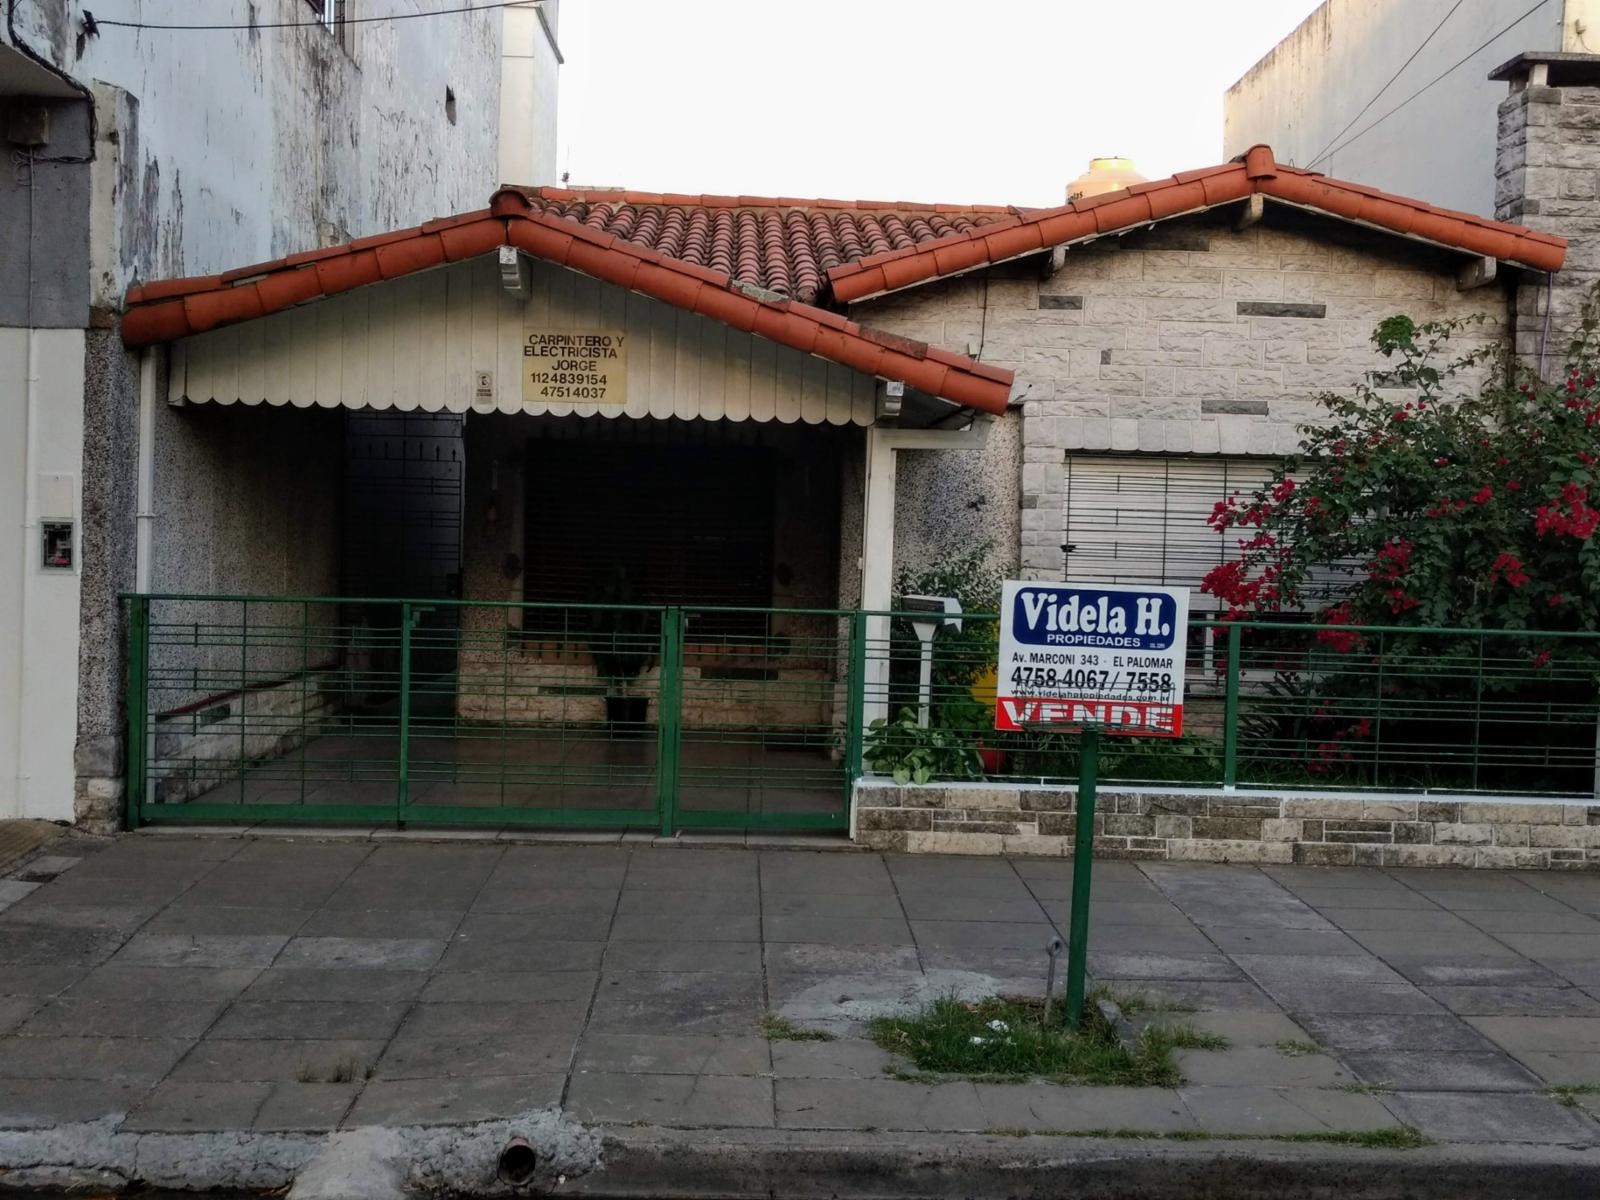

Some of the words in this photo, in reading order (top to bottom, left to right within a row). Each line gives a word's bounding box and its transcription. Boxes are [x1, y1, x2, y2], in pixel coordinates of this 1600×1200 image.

[528, 334, 612, 347] CARPINTERO
[616, 336, 625, 348] Y
[524, 346, 618, 359] ELECTRICISTA
[552, 360, 597, 372] JORGE
[530, 372, 608, 385] 1124839154
[540, 386, 607, 399] 47514037
[1020, 592, 1127, 635] Videla
[1134, 597, 1171, 637] H.
[1046, 634, 1141, 648] PROPIEDADES
[1012, 652, 1027, 664] Av.
[1029, 653, 1075, 666] MARCONI
[1080, 654, 1099, 666] 343
[1113, 656, 1125, 667] EL
[1127, 656, 1173, 669] PALOMAR
[1126, 671, 1172, 693] 7558
[1002, 701, 1174, 732] VENDE
